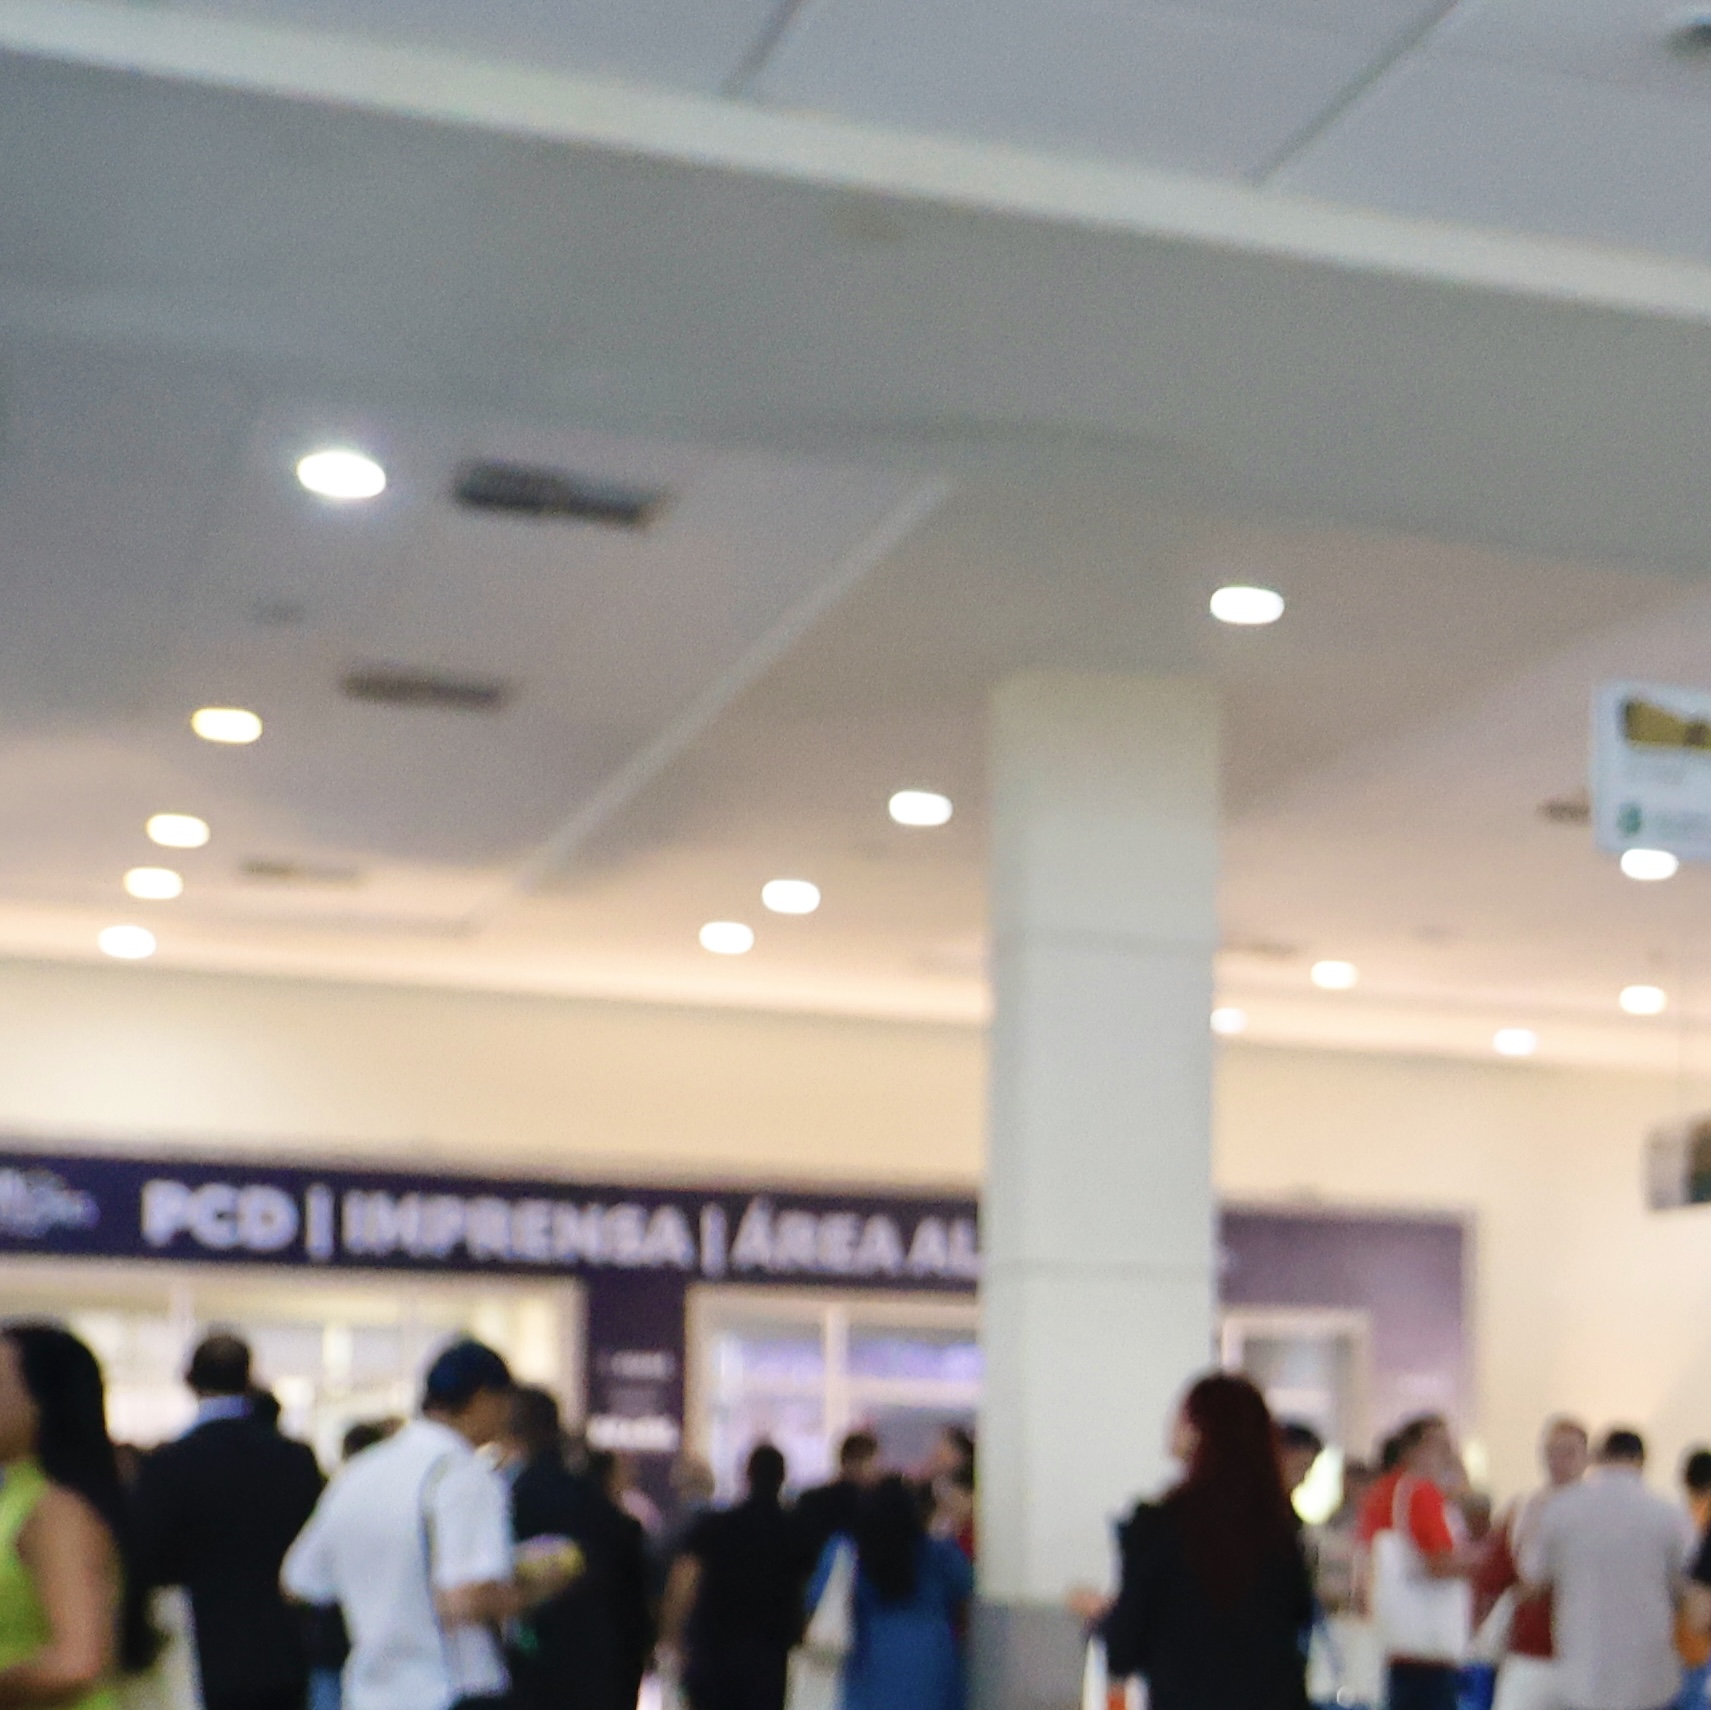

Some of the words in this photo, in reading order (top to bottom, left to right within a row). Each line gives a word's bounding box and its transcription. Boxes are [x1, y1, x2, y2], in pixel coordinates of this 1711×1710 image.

[141, 1178, 298, 1250] PCD
[341, 1187, 698, 1268] IMPRENSA
[730, 1195, 904, 1275] ÁREA
